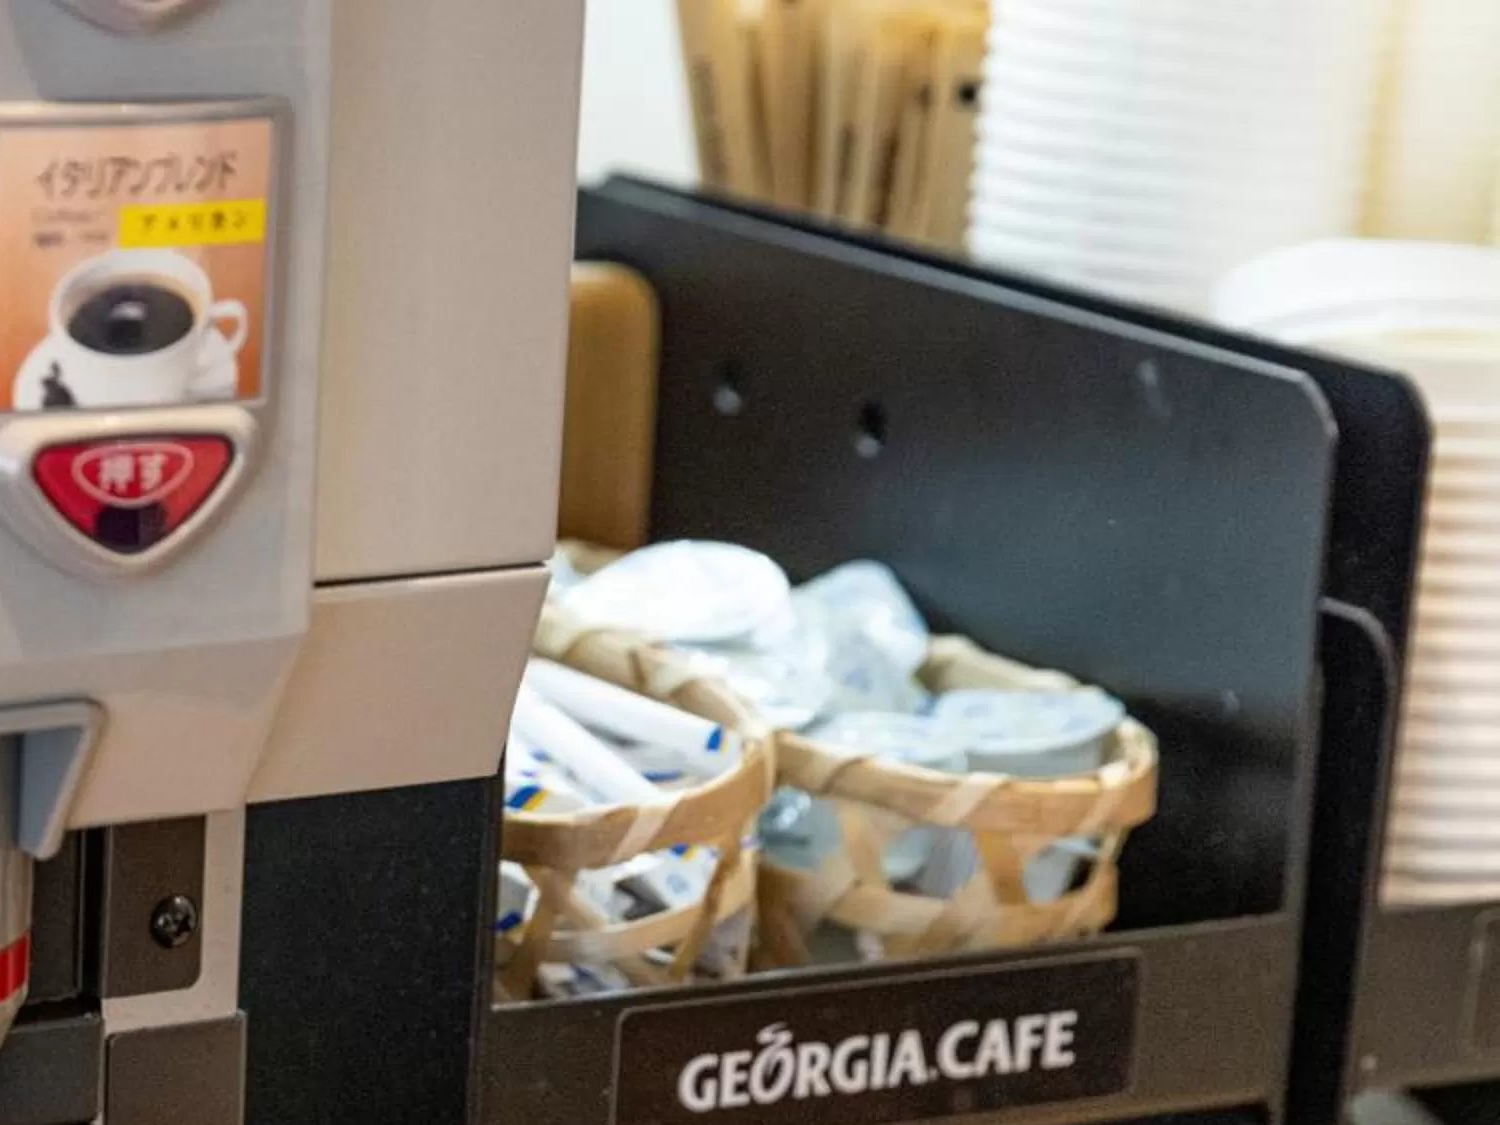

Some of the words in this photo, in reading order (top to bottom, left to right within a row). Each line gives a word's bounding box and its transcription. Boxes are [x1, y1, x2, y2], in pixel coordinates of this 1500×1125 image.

[34, 151, 238, 198] イタリアンブレンド
[100, 452, 168, 493] 押す
[677, 1021, 930, 1113] GEORGIA
[934, 1010, 1078, 1080] CAFE
